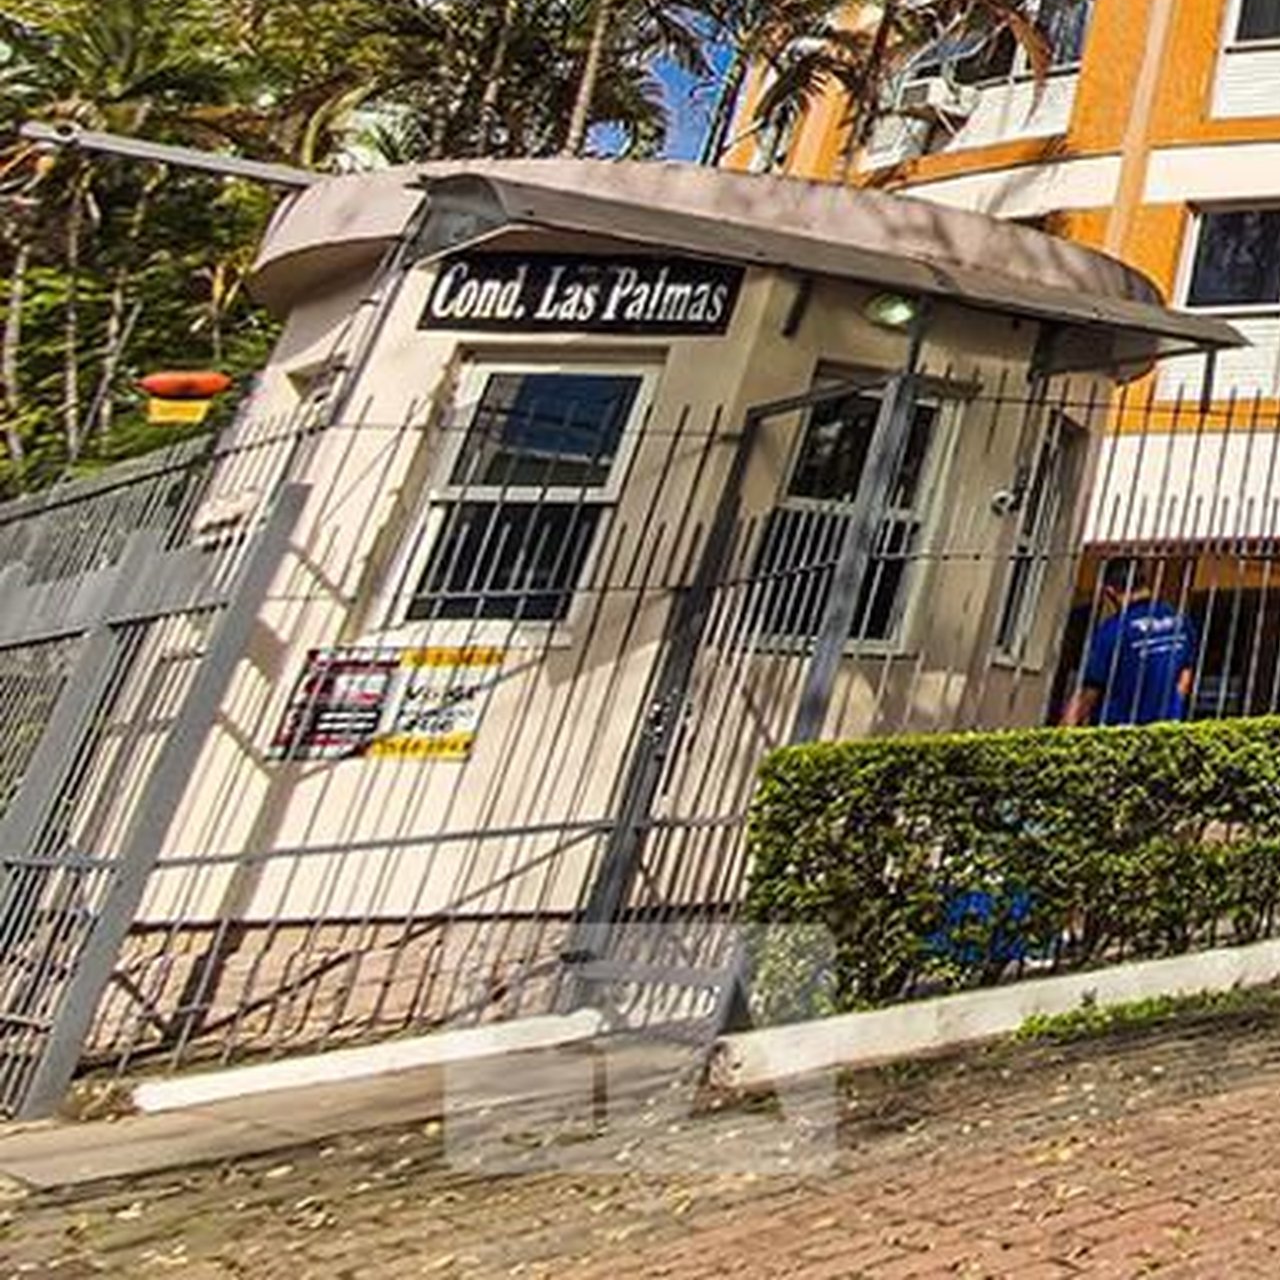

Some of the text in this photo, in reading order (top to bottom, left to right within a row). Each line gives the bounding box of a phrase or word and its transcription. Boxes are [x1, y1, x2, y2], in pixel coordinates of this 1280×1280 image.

[431, 262, 728, 322] Cond. Las Palmas
